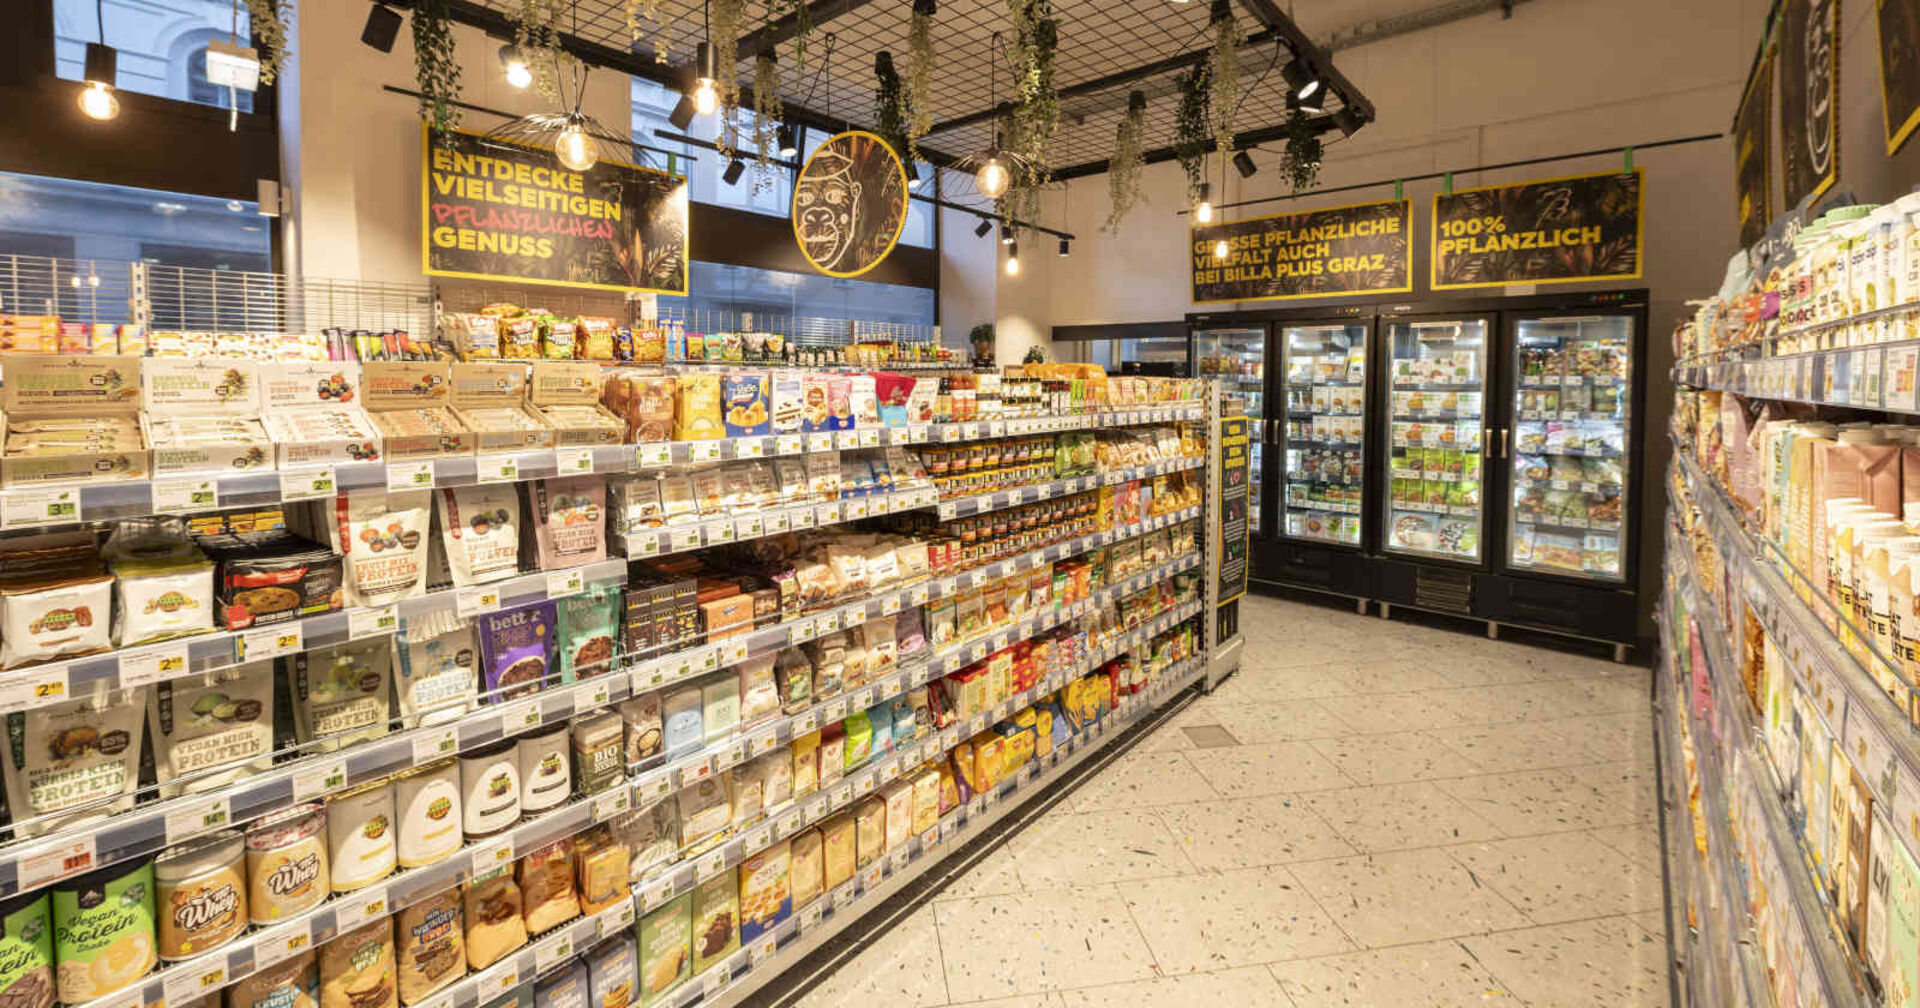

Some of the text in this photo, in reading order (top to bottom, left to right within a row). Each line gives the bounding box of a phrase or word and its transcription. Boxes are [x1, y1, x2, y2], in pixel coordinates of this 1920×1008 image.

[433, 148, 584, 194] ENTDECKE
[432, 172, 622, 221] VIELSEITIGEN
[431, 202, 613, 240] PFLANZLICHEN
[1194, 217, 1400, 255] GRSSE PFLANZLICHE
[1440, 215, 1507, 238] 100%
[433, 226, 554, 259] GENUSS
[1277, 242, 1331, 262] AUCH
[1440, 225, 1602, 257] PFLANZLICH
[1195, 253, 1386, 285] BEI BILLA PLUS GRAZ
[180, 738, 261, 769] PROTEIN
[31, 771, 124, 805] PROTEIN
[267, 860, 321, 895] Whey
[177, 889, 238, 931] Whey
[57, 911, 139, 944] Protein
